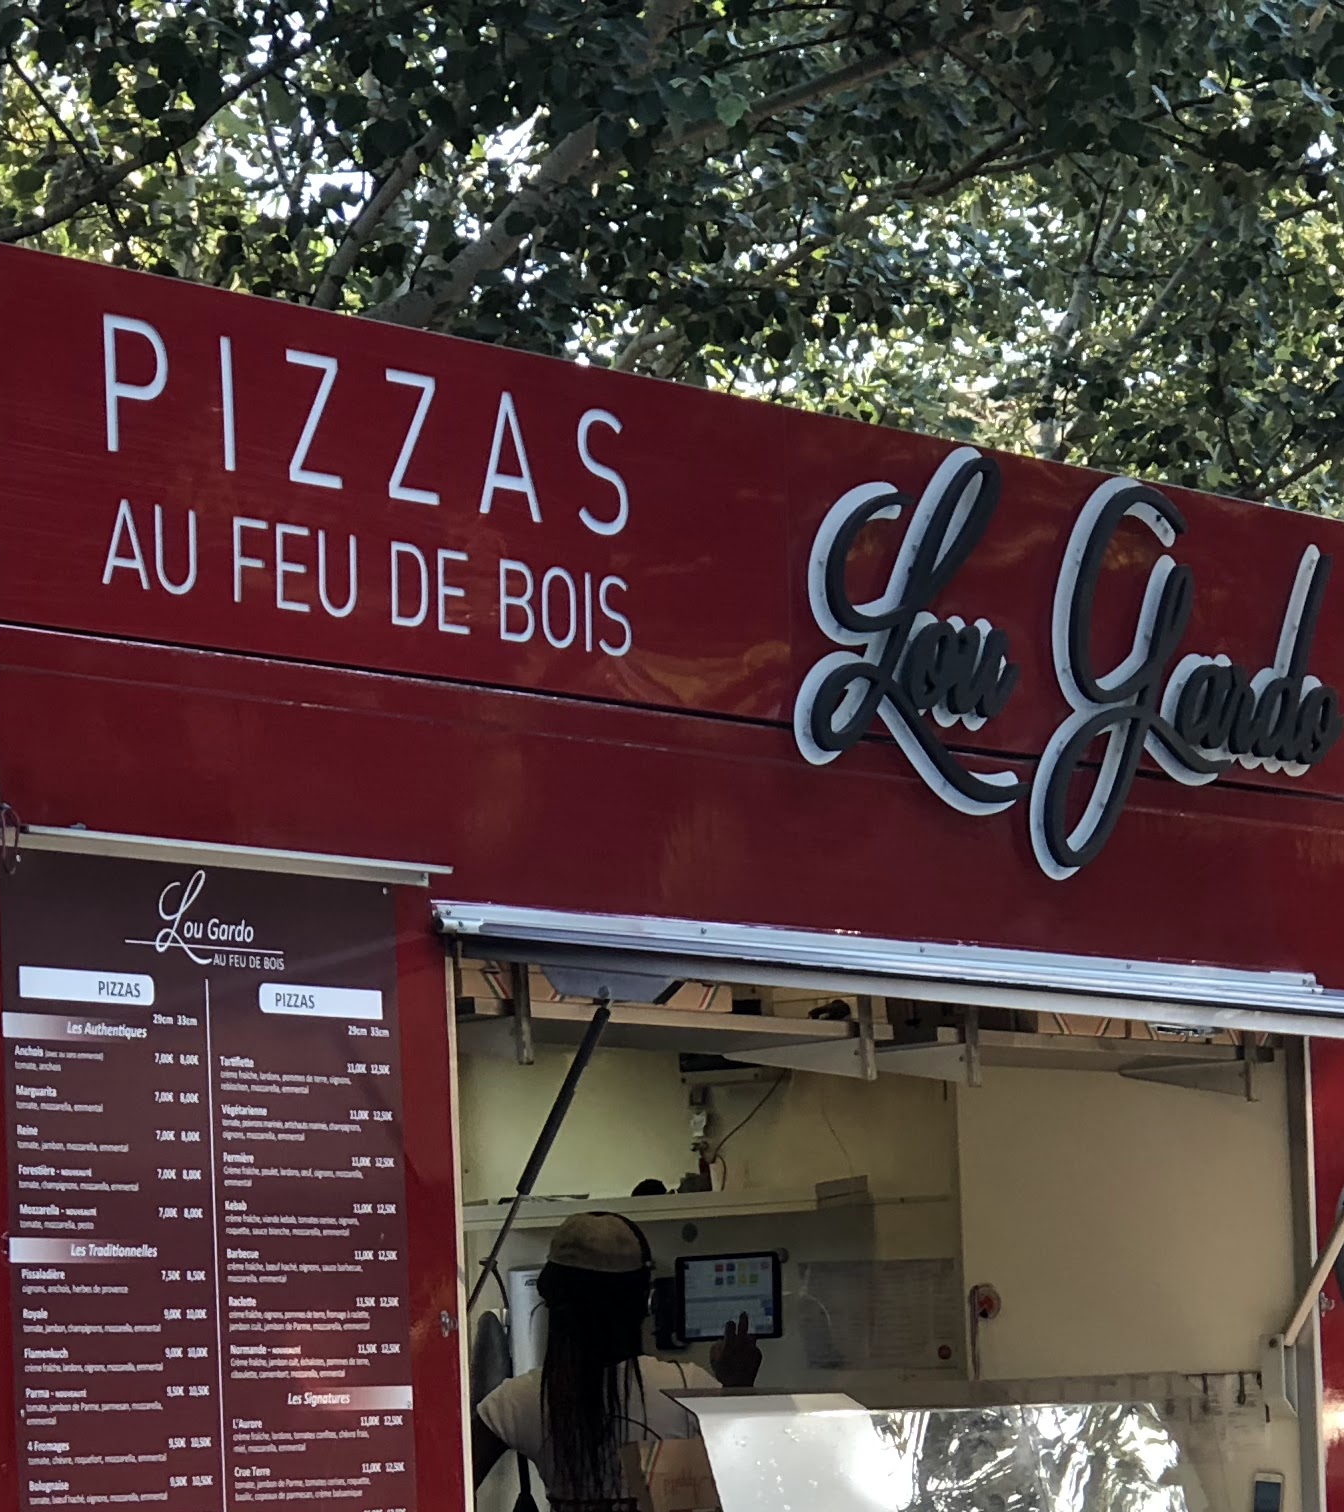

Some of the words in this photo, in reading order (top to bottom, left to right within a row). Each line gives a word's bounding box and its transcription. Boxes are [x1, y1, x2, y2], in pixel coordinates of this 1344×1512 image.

[103, 312, 629, 536] PIZZAS
[102, 499, 198, 595] AU
[233, 515, 356, 618] FEU
[391, 540, 471, 635] DE
[500, 557, 633, 657] BOIS
[794, 447, 1033, 816] Lou
[1029, 477, 1344, 880] Gardo
[156, 869, 212, 966] Lou
[207, 920, 254, 943] Gardo
[212, 953, 226, 967] AU
[229, 954, 247, 968] FEU
[249, 955, 262, 969] DE
[264, 956, 285, 970] BOIS
[98, 980, 141, 998] PIZZAS
[275, 992, 315, 1010] PIZZAS
[153, 1014, 174, 1025] 29cm
[176, 1015, 197, 1026] 33cm
[67, 1021, 83, 1034] Les
[84, 1022, 148, 1040] Authentiques
[348, 1025, 367, 1036] 29cm
[370, 1027, 389, 1037] 33cm
[224, 1200, 248, 1211] Kebab
[70, 1244, 86, 1257] Les
[88, 1244, 158, 1258] Traditionnelles
[22, 1308, 48, 1321] Royale
[287, 1393, 302, 1405] Les
[303, 1391, 350, 1407] Signatures
[27, 1441, 33, 1451] 4
[34, 1441, 70, 1453] Fromages
